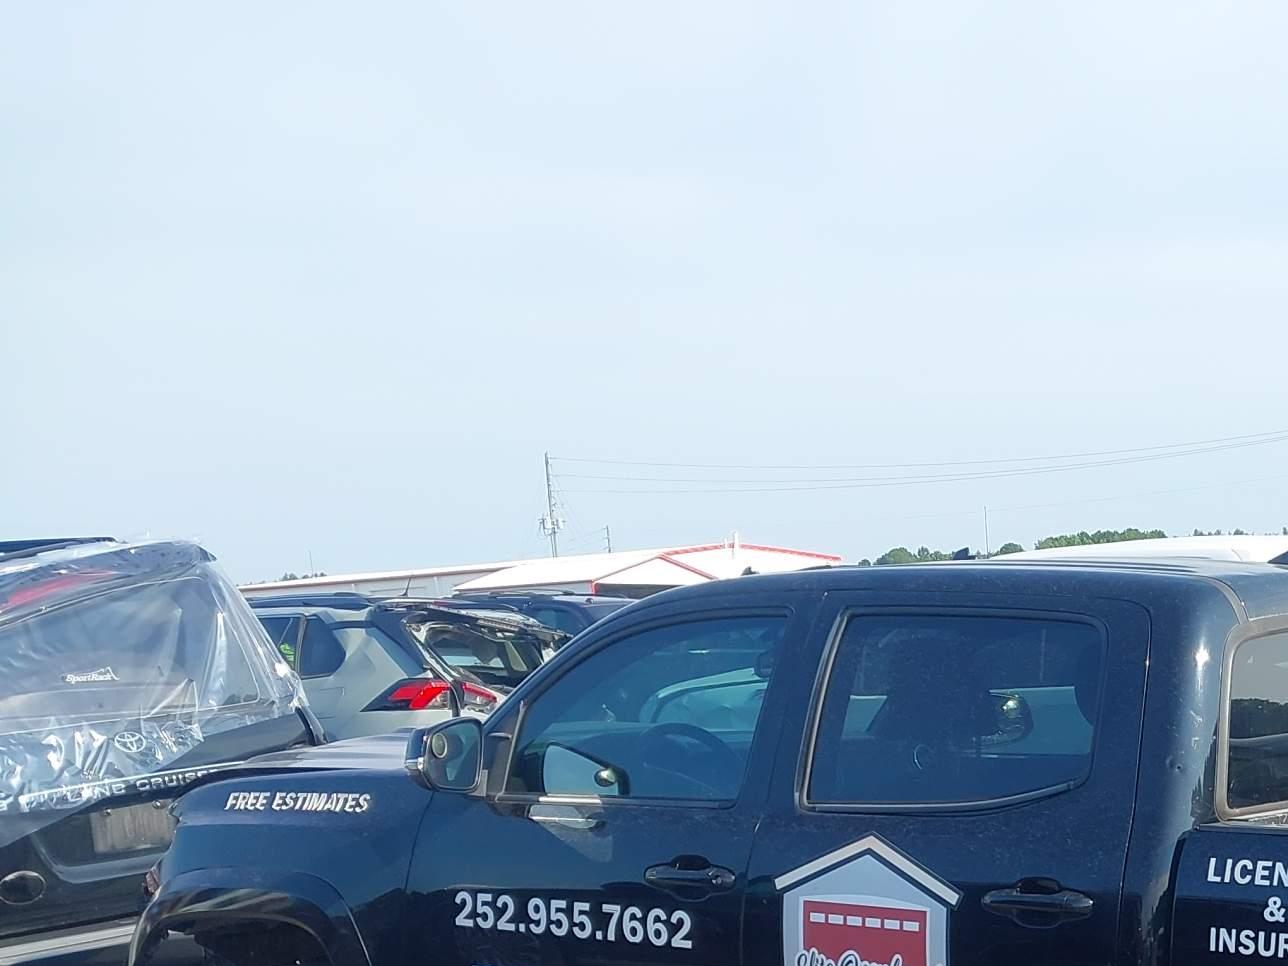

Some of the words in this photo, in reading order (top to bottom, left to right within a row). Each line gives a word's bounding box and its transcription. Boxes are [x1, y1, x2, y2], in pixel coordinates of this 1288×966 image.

[224, 792, 271, 811] FREE
[272, 792, 371, 813] ESTIMATES
[454, 890, 693, 950] 252.955.7662
[1263, 896, 1286, 923] &
